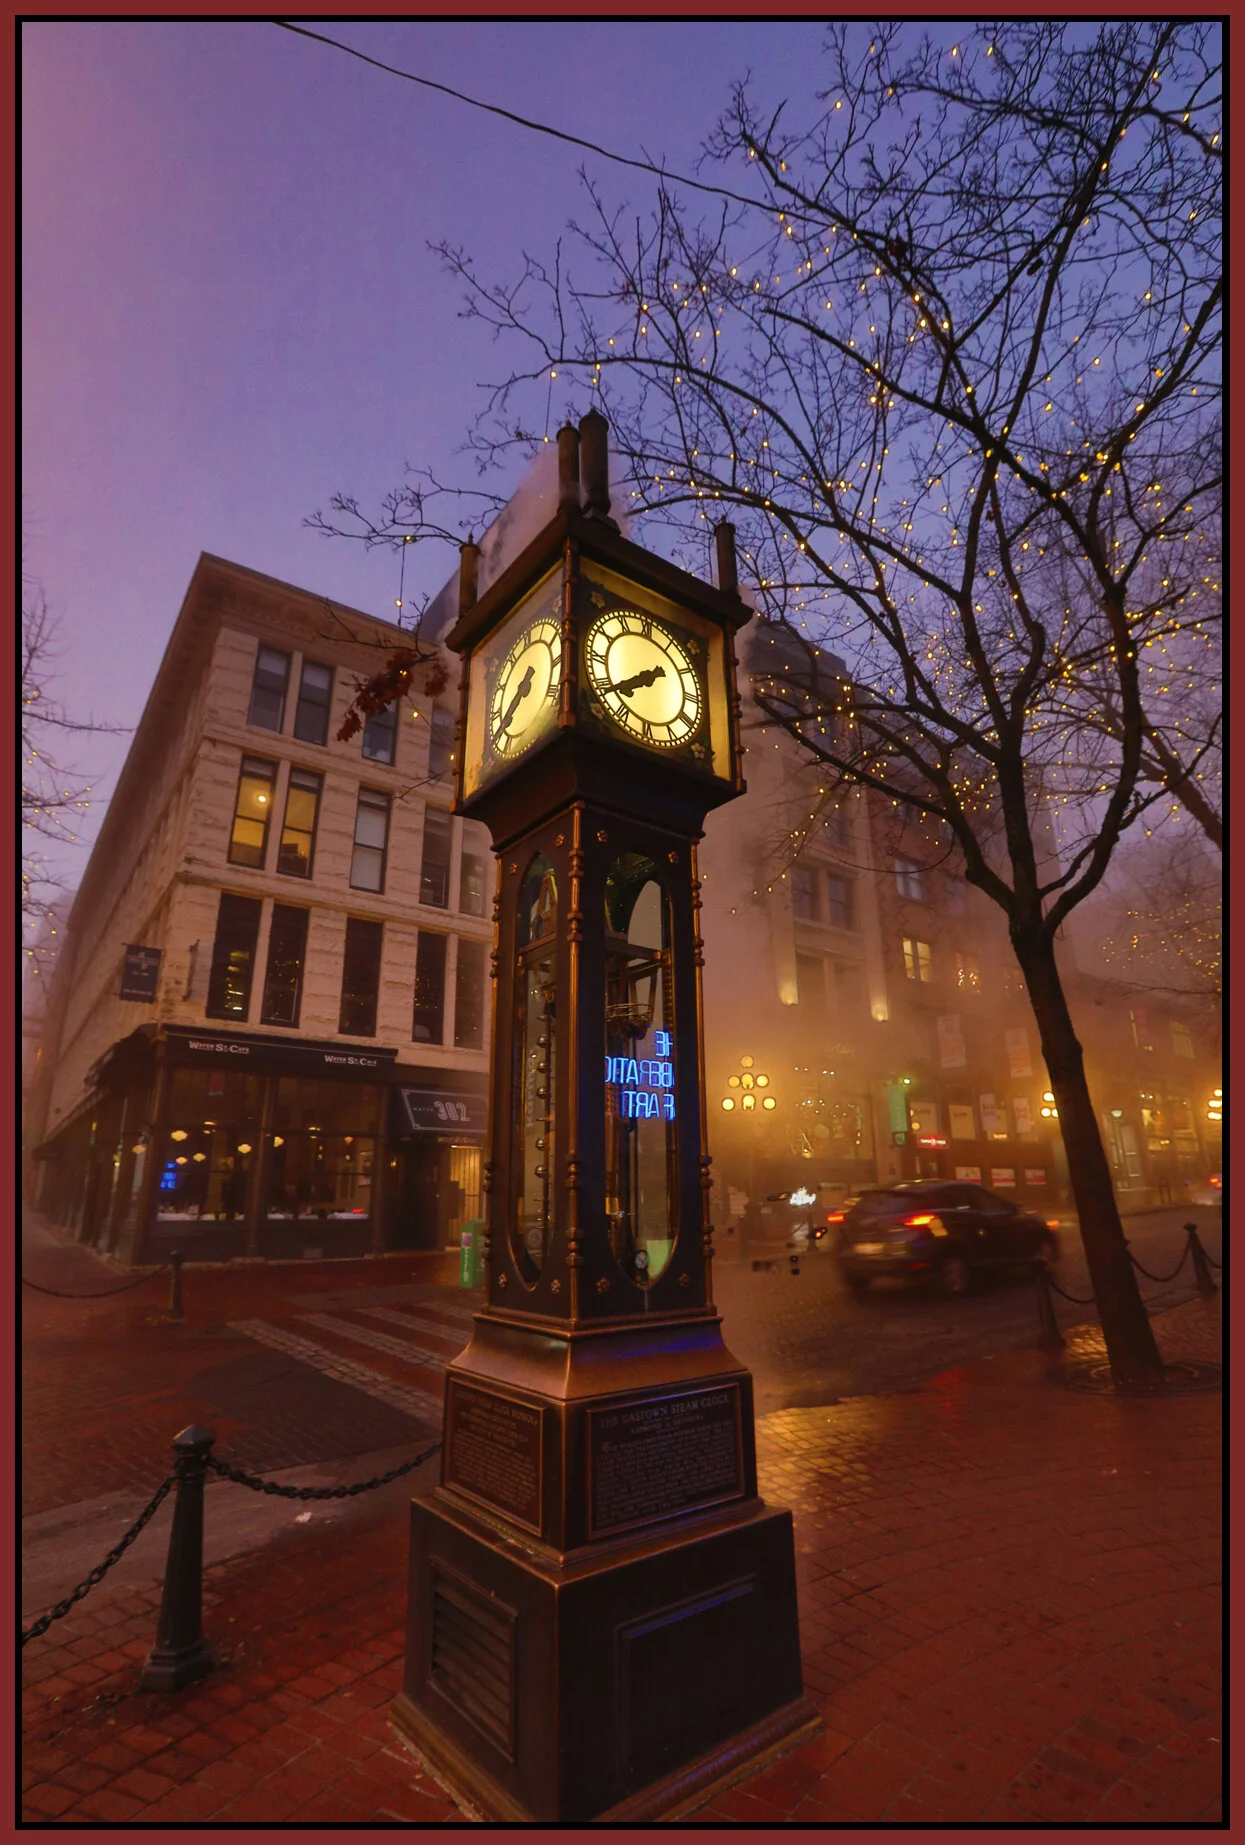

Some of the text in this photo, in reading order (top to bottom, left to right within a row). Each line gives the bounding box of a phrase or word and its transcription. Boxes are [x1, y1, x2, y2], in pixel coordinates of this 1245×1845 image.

[434, 1100, 471, 1122] 302
[621, 1407, 668, 1425] GASTOWN
[671, 1400, 699, 1415] STEAM
[701, 1393, 729, 1408] CLOCK
